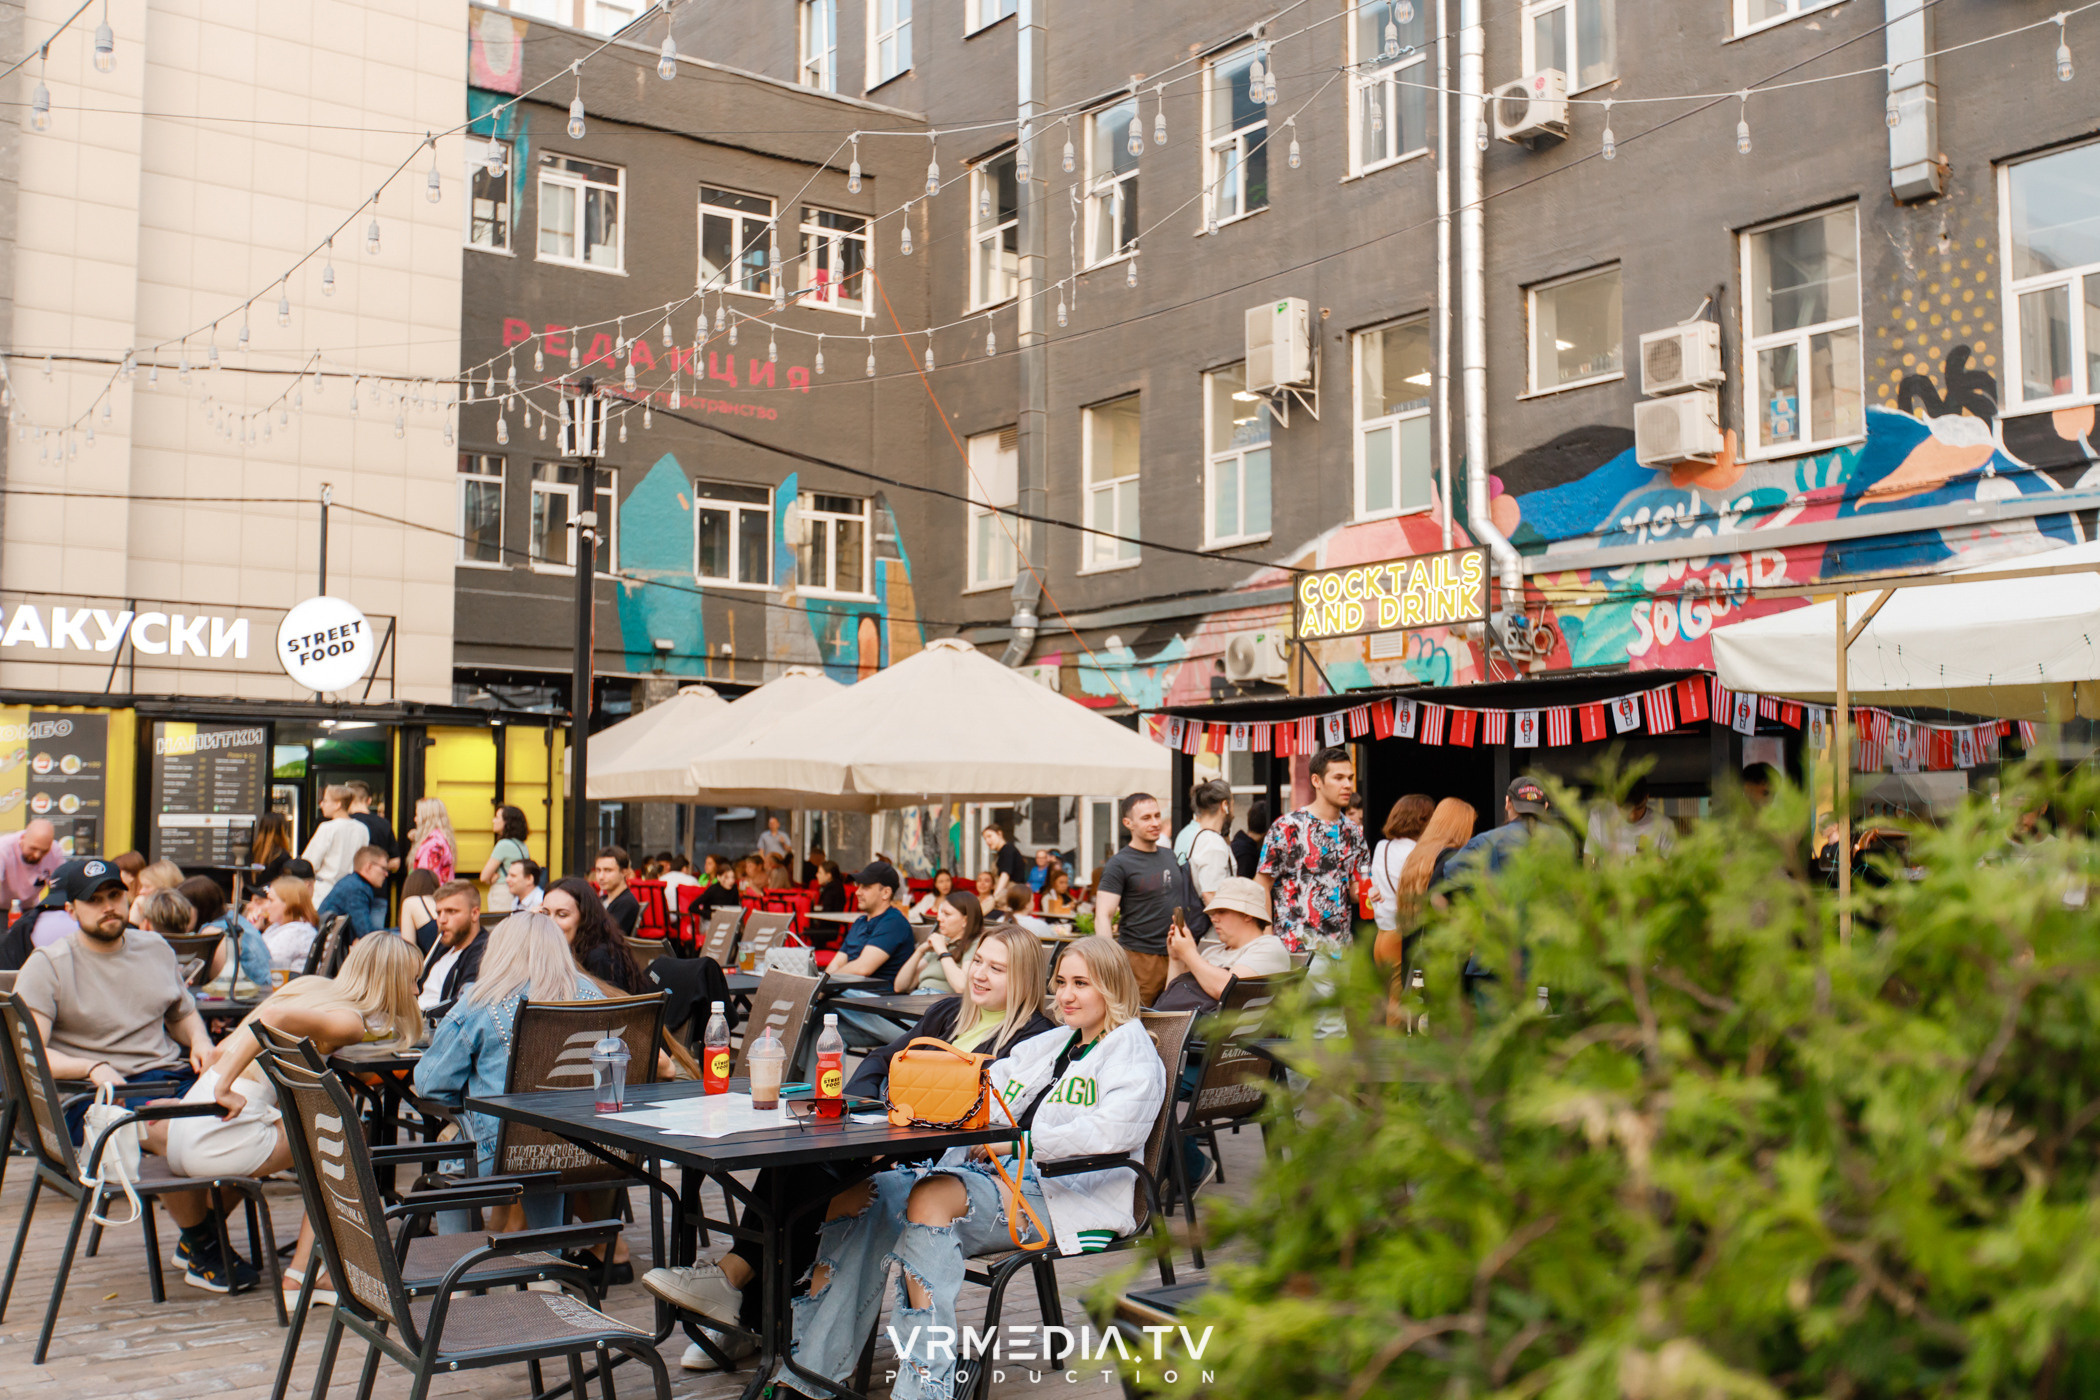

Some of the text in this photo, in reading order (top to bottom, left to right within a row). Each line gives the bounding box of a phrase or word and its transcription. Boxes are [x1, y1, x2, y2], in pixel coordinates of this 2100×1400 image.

[1300, 552, 1482, 607] COCKTAILS
[1300, 583, 1482, 638] AND DRINK
[0, 604, 249, 659] АКУСКИ
[287, 620, 362, 652] STREET
[299, 640, 355, 666] FOOD
[0, 718, 73, 742] ОМБО
[156, 728, 264, 755] НАПИТКИ
[1523, 711, 1531, 743] MARTIN
